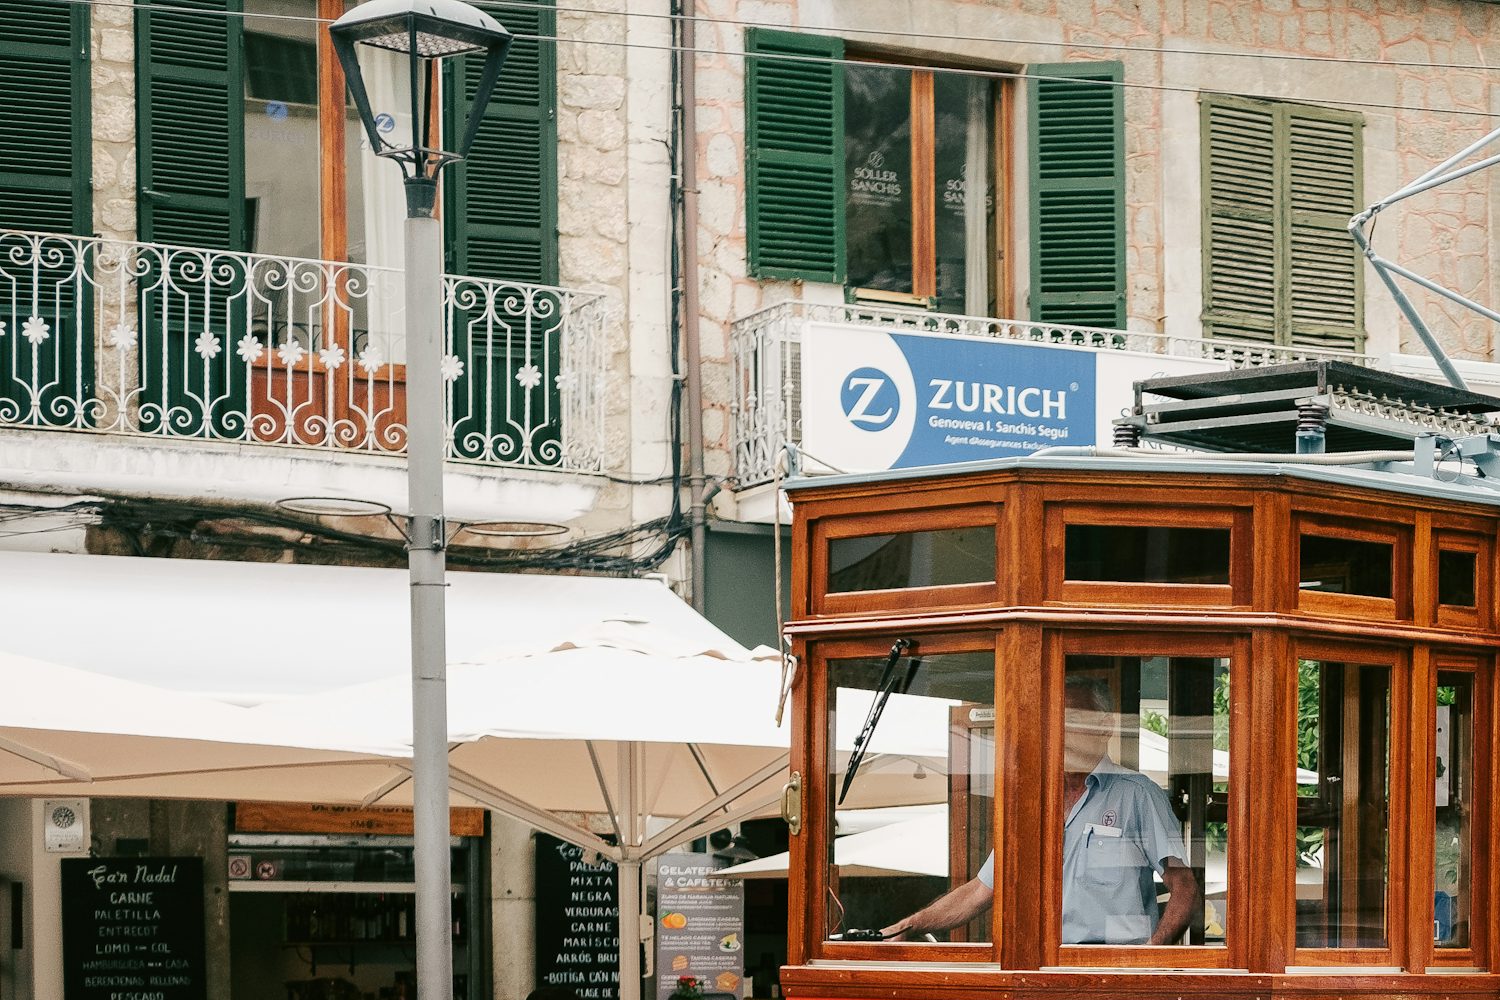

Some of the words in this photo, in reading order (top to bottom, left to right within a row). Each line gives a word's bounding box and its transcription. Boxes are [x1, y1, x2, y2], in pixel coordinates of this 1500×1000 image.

[850, 179, 901, 195] SANCHIS
[848, 377, 893, 424] Z
[928, 378, 1067, 420] ZURICH
[928, 415, 983, 431] Genoveva
[996, 421, 1036, 436] Sanchis
[944, 434, 968, 446] Agent
[134, 865, 177, 883] Nadal
[664, 877, 675, 887] &
[110, 892, 153, 904] CARNE
[571, 891, 612, 902] NEGRA
[95, 910, 161, 920] PALETILLA
[565, 907, 619, 917] VERDURAS
[98, 926, 158, 937] ENTRECOT
[570, 922, 612, 933] CARNE
[95, 943, 130, 954] LOMO
[151, 943, 171, 953] COL
